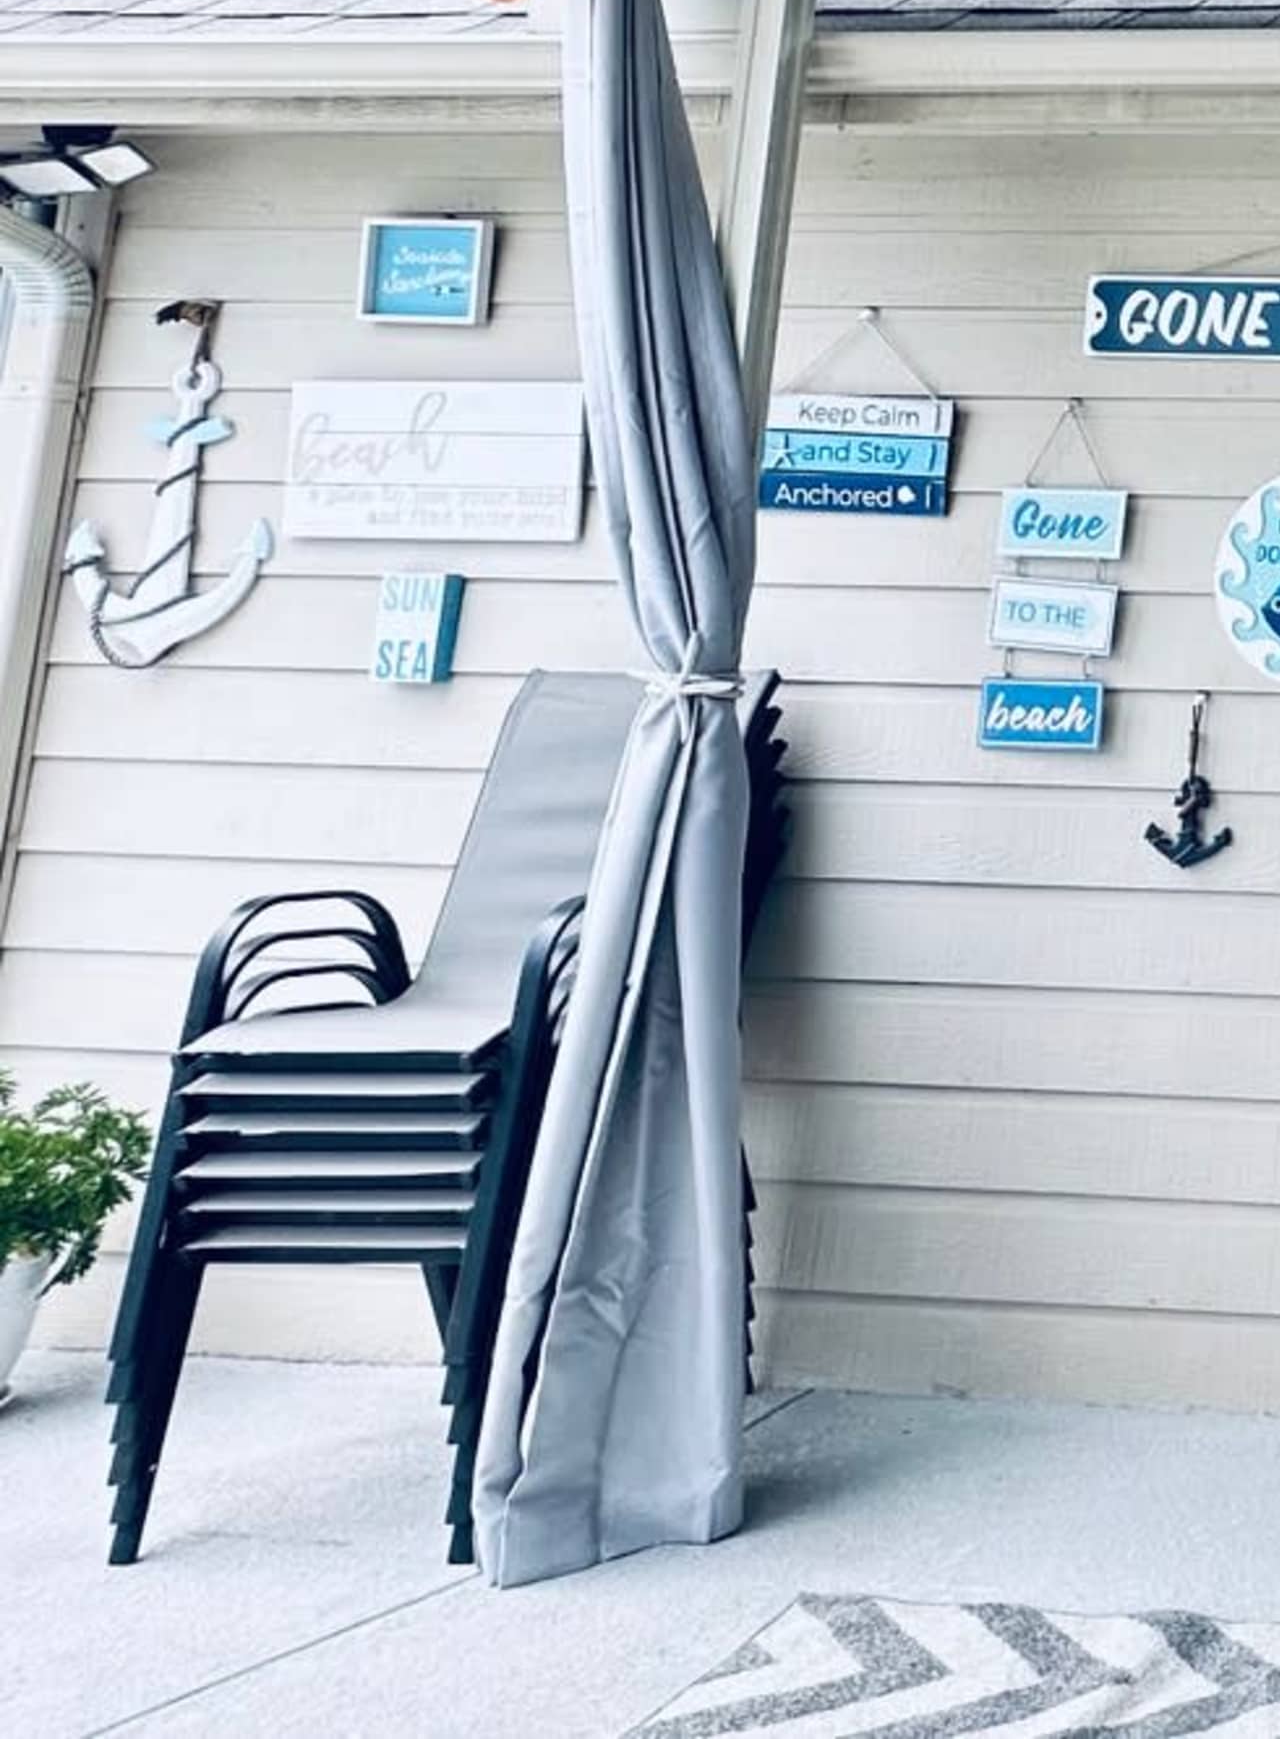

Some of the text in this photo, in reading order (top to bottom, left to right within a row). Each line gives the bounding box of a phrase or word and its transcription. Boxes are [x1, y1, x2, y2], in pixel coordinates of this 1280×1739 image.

[1118, 289, 1280, 348] GONE
[800, 402, 920, 427] Keep Calm
[801, 442, 912, 470] and Stay
[774, 482, 893, 508] Anchored
[1013, 499, 1108, 541] Gone
[383, 576, 441, 612] SUN
[1007, 601, 1086, 628] TO THE
[376, 639, 427, 678] SEA
[986, 692, 1092, 733] beach
